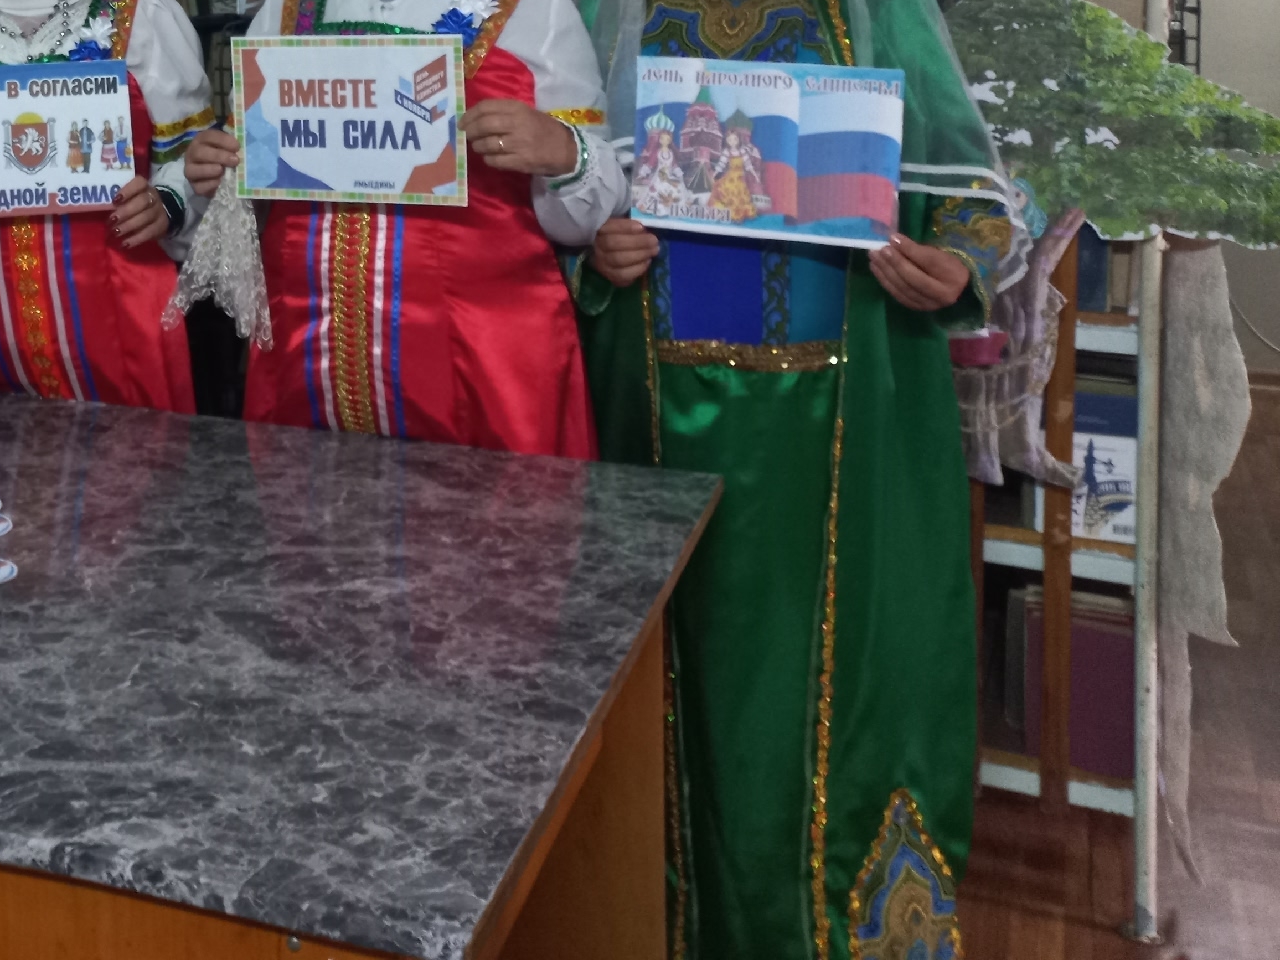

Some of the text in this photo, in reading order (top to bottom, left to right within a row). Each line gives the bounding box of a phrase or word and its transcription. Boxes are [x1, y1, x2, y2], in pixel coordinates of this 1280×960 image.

[28, 76, 119, 98] согласии
[278, 78, 378, 109] ВМЕСТЕ
[281, 119, 422, 152] МЫ СИЛА
[57, 184, 121, 206] земле
[645, 196, 658, 215] 4
